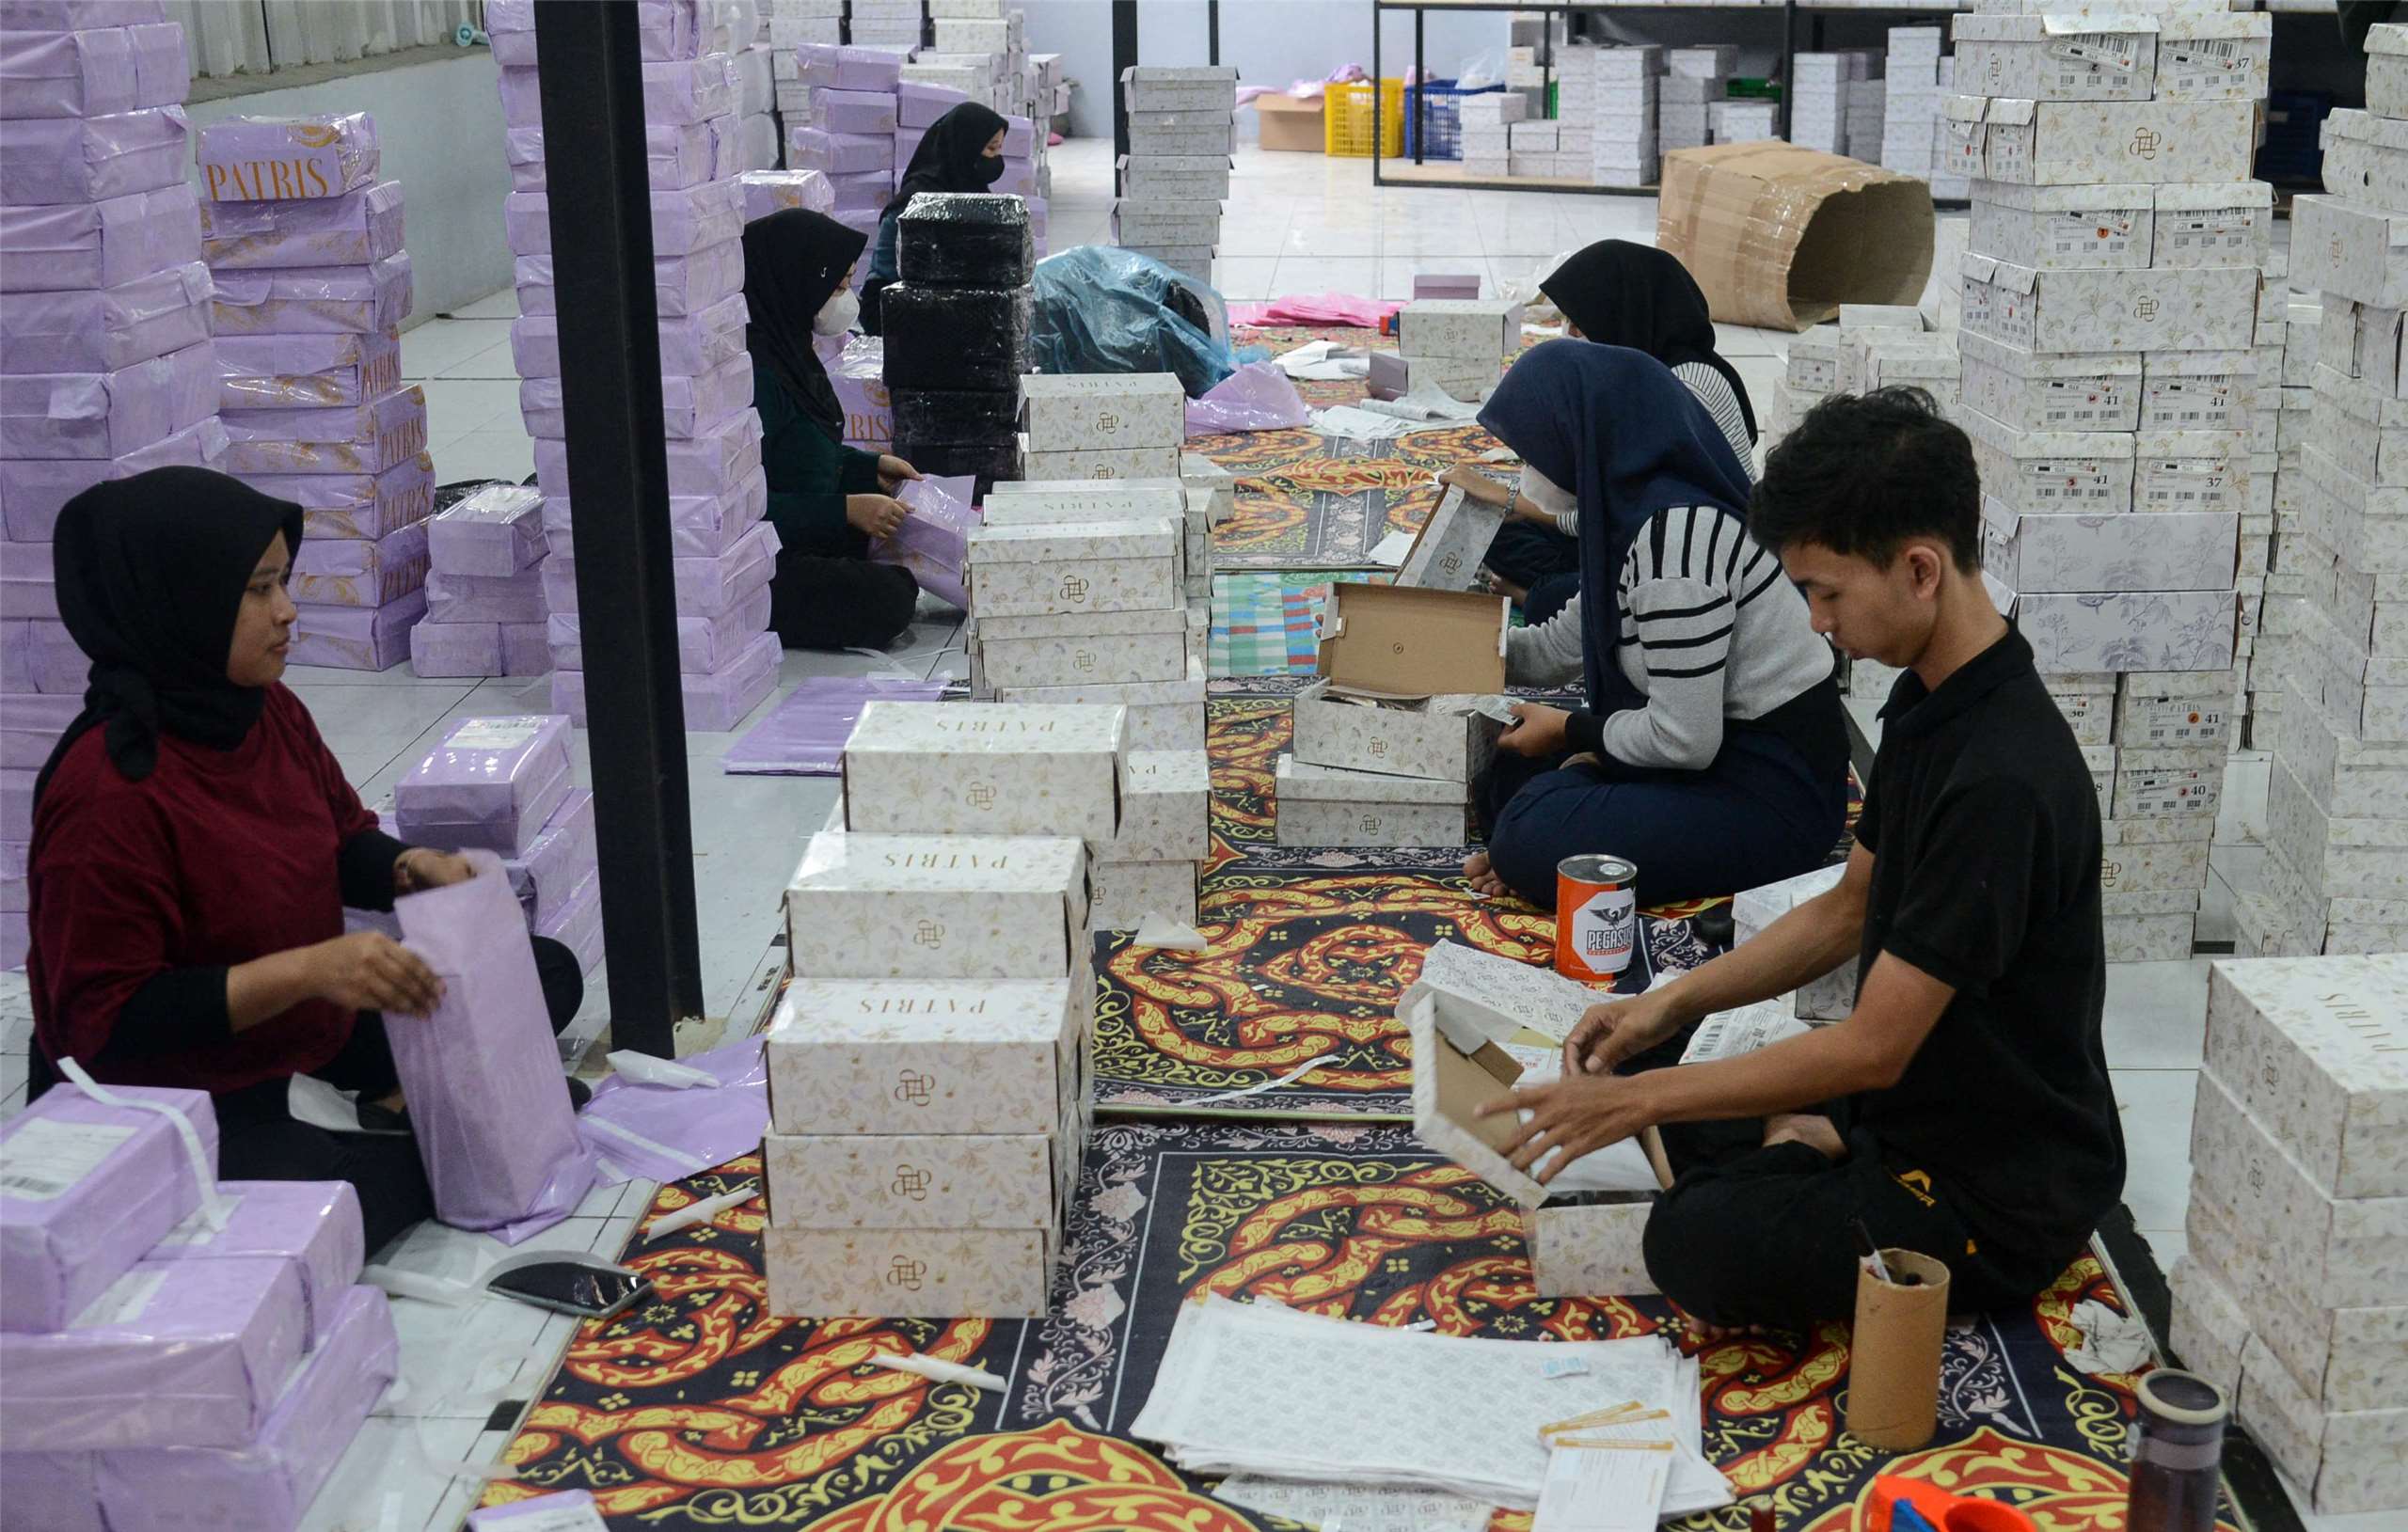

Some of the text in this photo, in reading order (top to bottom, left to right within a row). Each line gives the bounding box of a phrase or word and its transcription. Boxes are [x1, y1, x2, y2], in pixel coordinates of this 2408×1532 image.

[206, 158, 328, 201] PATRIS
[2103, 395, 2119, 405] 41
[850, 414, 890, 440] RIS
[2093, 474, 2109, 485] 41
[2205, 477, 2223, 488] 37
[2205, 714, 2220, 724] 41
[936, 720, 1055, 733] PATRIS
[2191, 785, 2207, 797] 40
[884, 853, 1008, 870] PATRIS
[1587, 924, 1633, 951] PEGASUS
[860, 999, 986, 1015] PATRIS
